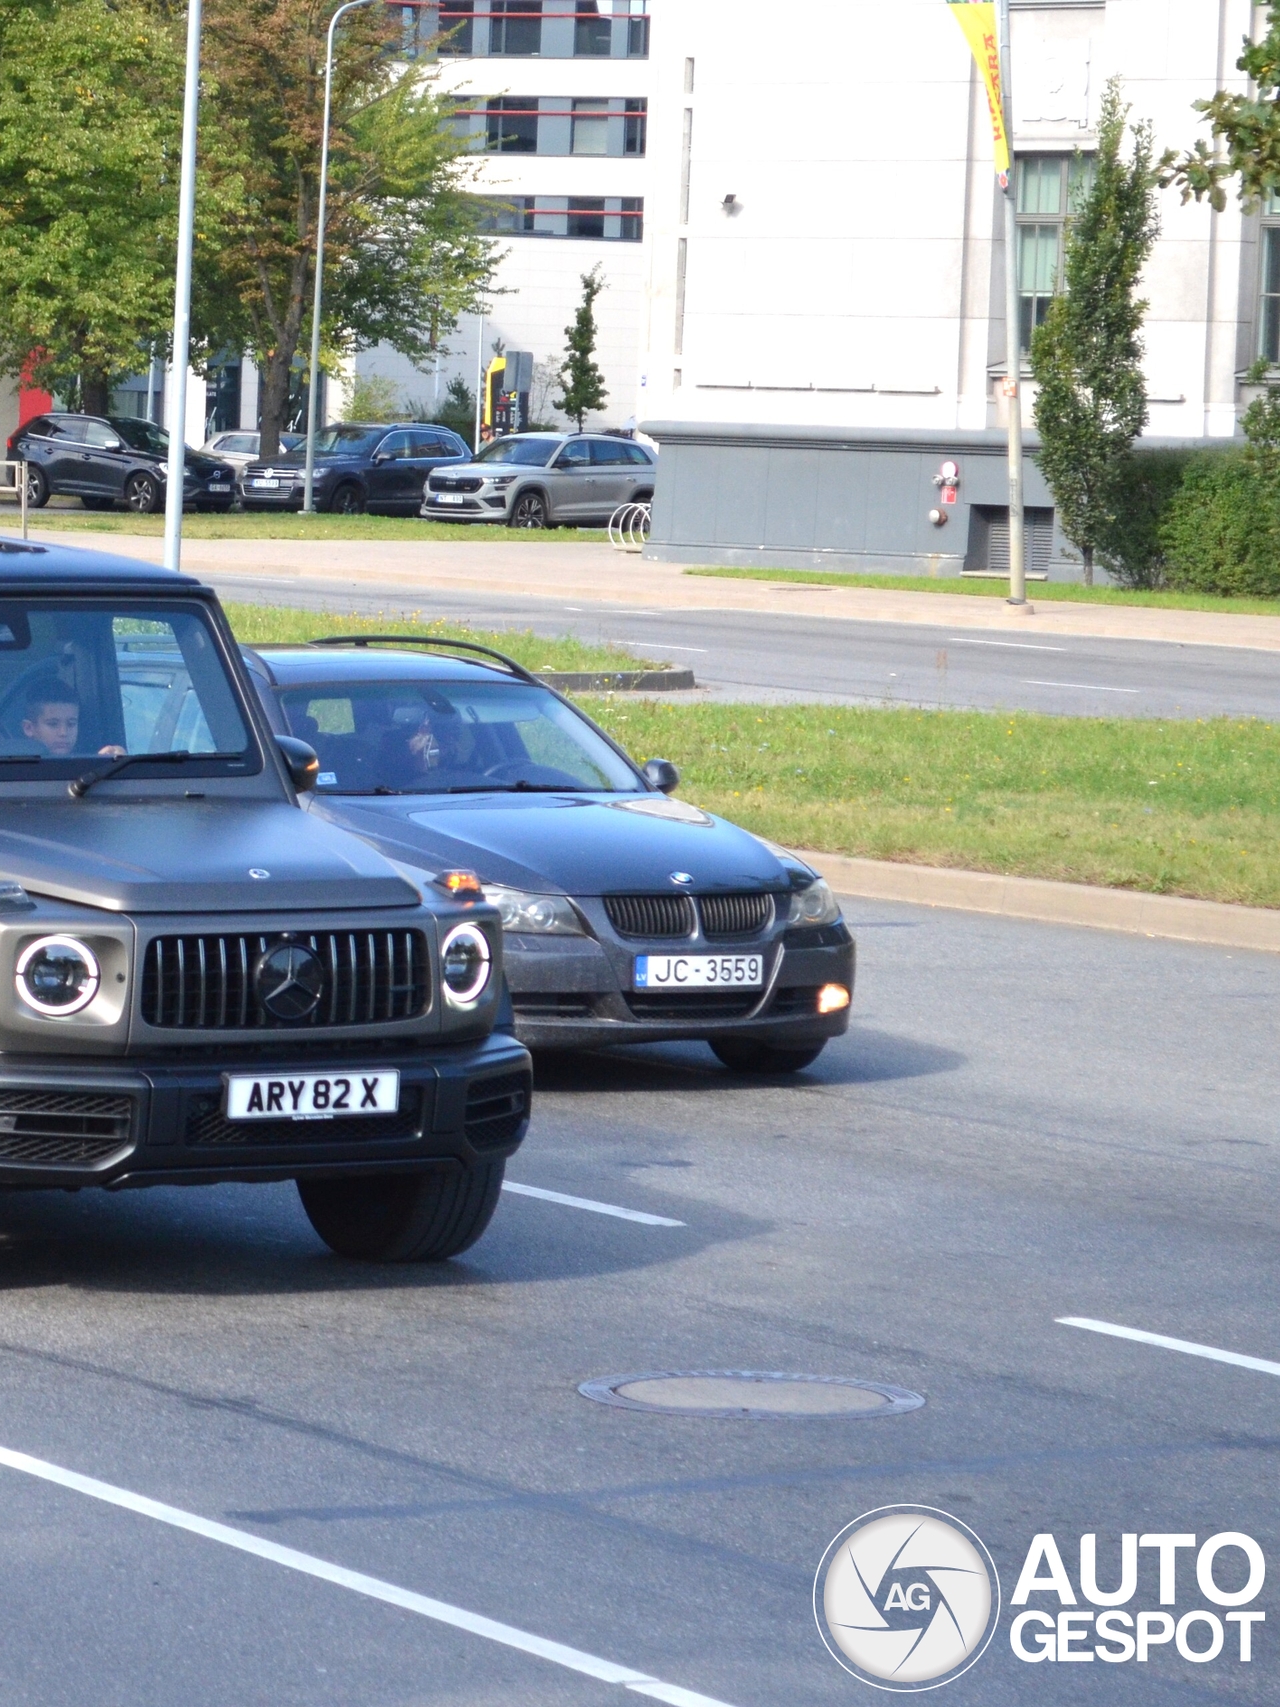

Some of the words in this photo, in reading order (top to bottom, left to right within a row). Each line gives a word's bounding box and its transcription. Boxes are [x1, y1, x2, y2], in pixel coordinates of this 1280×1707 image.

[636, 973, 647, 981] LV
[655, 958, 759, 982] JC-3559
[247, 1080, 305, 1112] ARY
